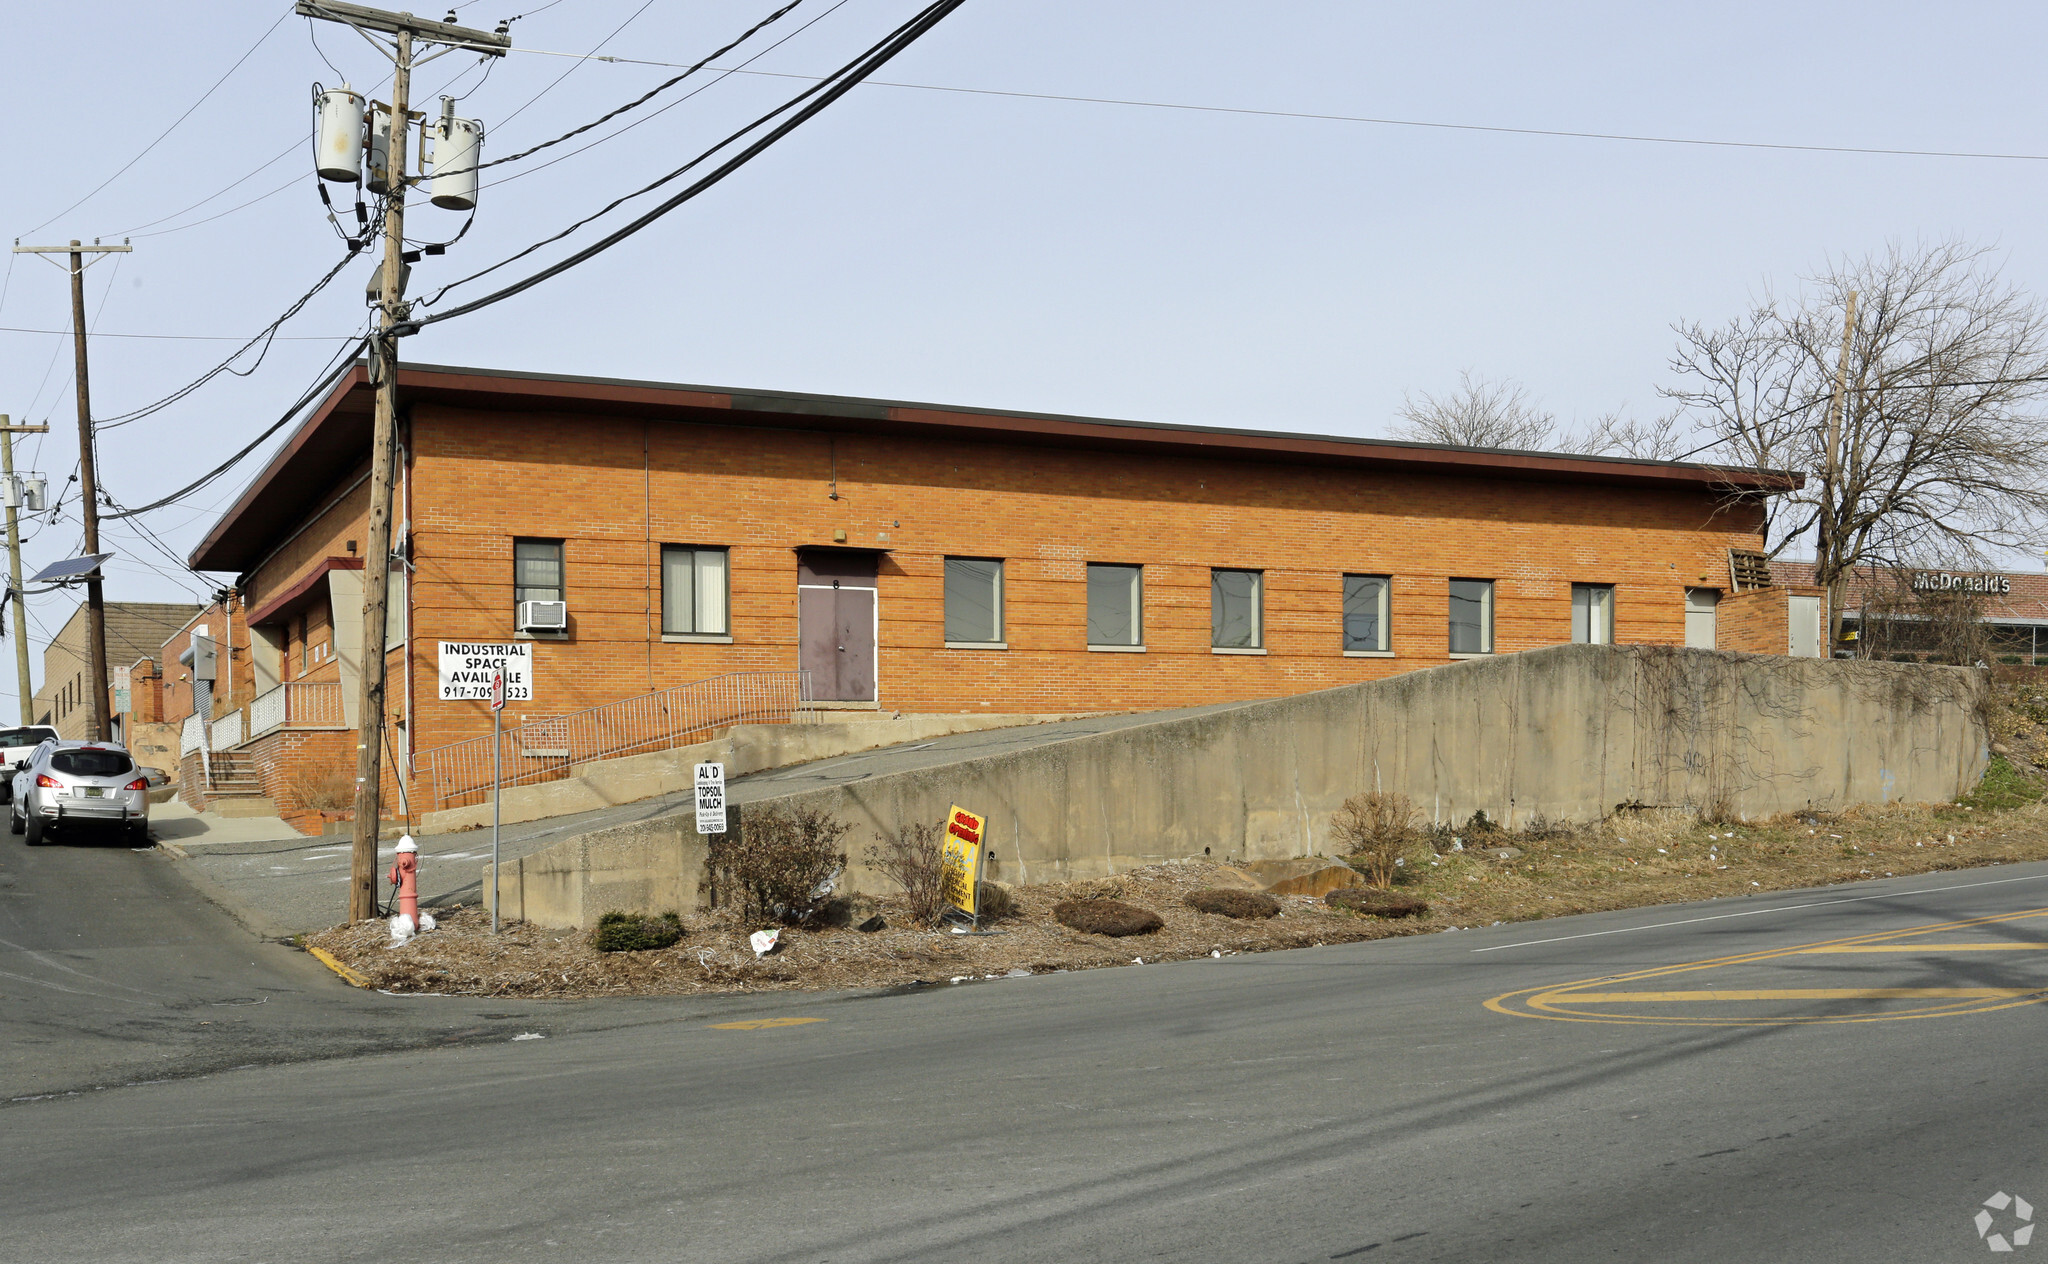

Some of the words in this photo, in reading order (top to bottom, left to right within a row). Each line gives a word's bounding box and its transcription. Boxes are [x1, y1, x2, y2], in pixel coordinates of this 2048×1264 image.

[833, 580, 839, 590] 8
[1914, 572, 2010, 593] McDonald's
[445, 644, 526, 656] INDUSTRIAL
[466, 658, 507, 669] SPACE
[451, 672, 521, 683] AVAILLE
[699, 766, 709, 779] AL
[698, 786, 722, 797] TOPSOIL
[699, 798, 722, 809] MULCH
[955, 811, 979, 830] GRAND
[949, 822, 979, 845] OPENING
